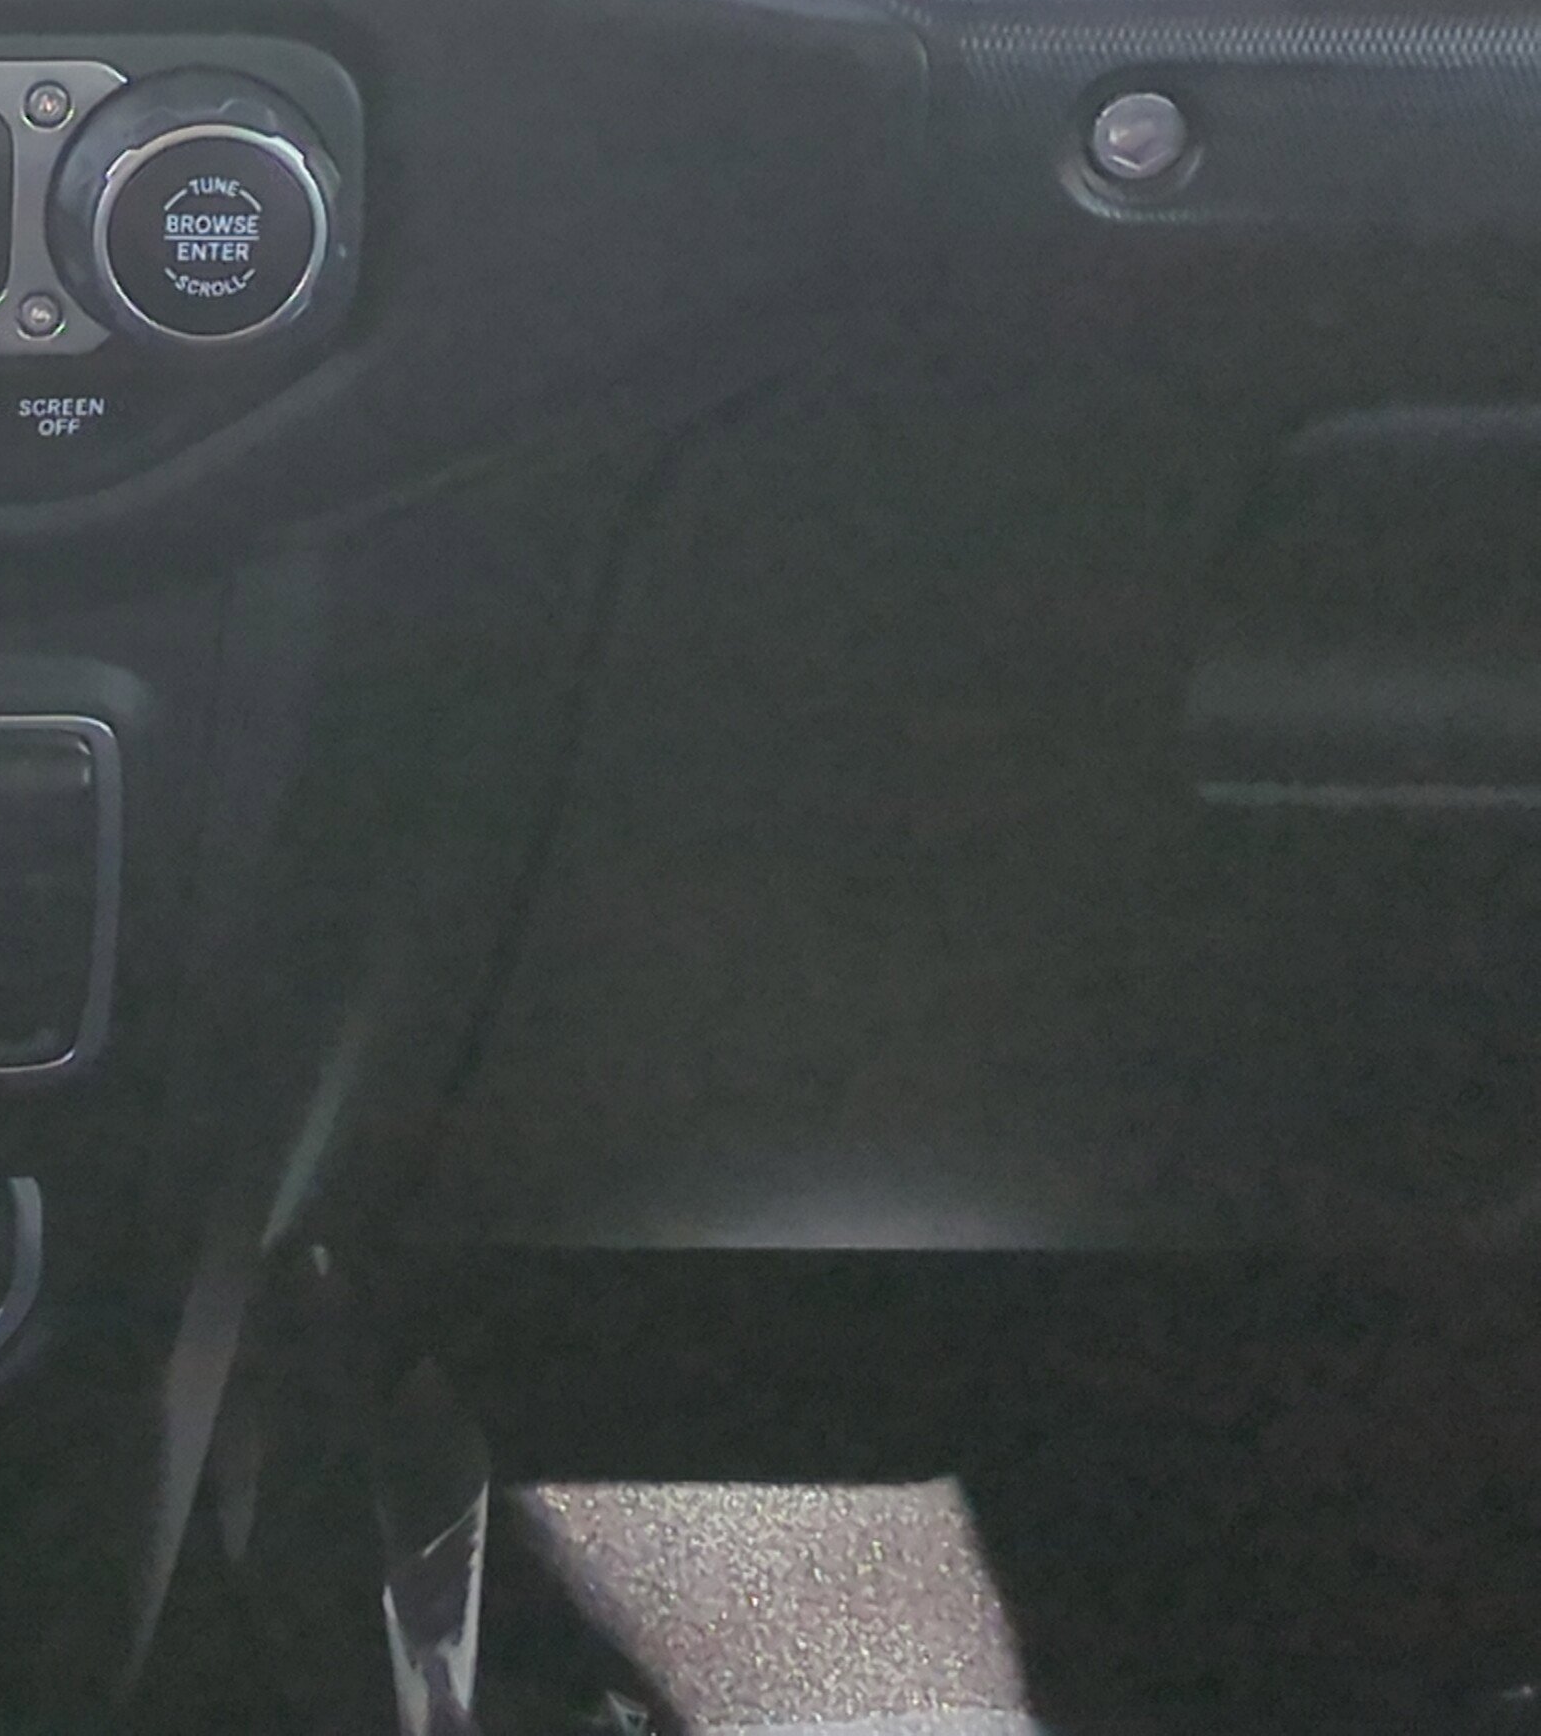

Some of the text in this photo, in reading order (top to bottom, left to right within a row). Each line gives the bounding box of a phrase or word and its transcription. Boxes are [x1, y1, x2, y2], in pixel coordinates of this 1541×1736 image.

[189, 176, 240, 197] TUNE
[166, 213, 259, 234] BROWSE
[177, 241, 249, 261] ENTER
[175, 275, 247, 297] SCROLL
[18, 397, 105, 419] SCREEN
[38, 417, 80, 437] OFF
